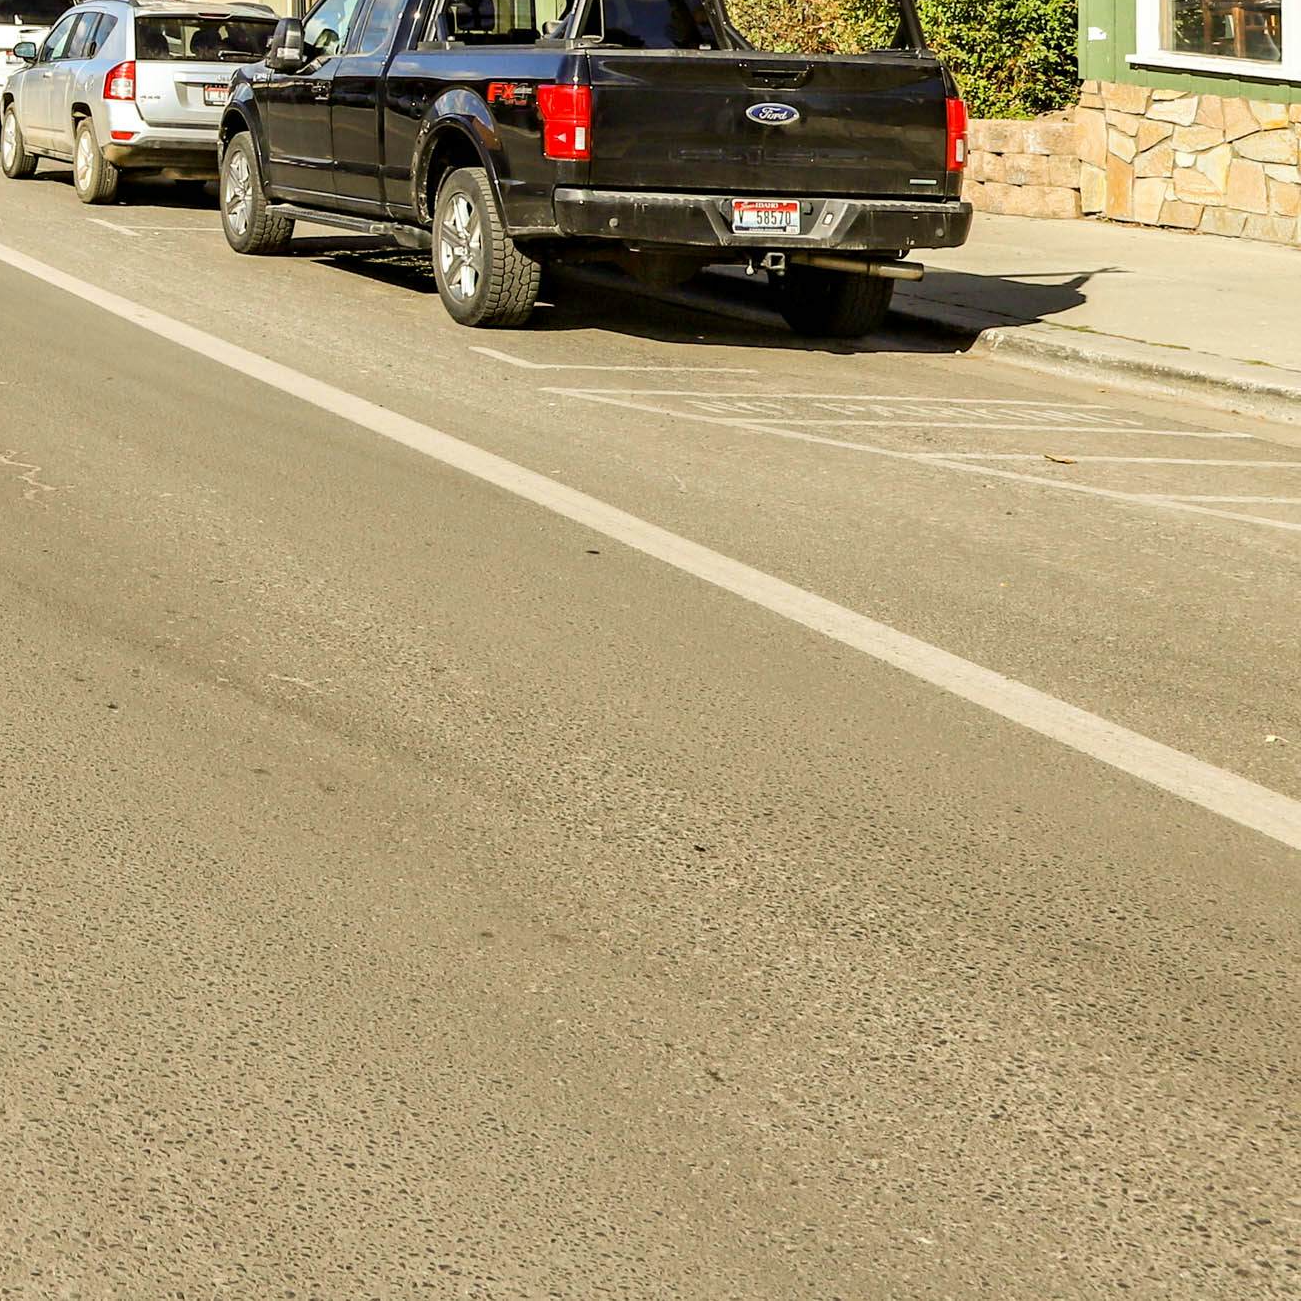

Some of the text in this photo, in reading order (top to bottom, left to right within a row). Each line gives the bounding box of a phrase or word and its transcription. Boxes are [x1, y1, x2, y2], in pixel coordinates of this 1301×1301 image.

[759, 107, 788, 120] Ford
[738, 210, 791, 225] V 58570
